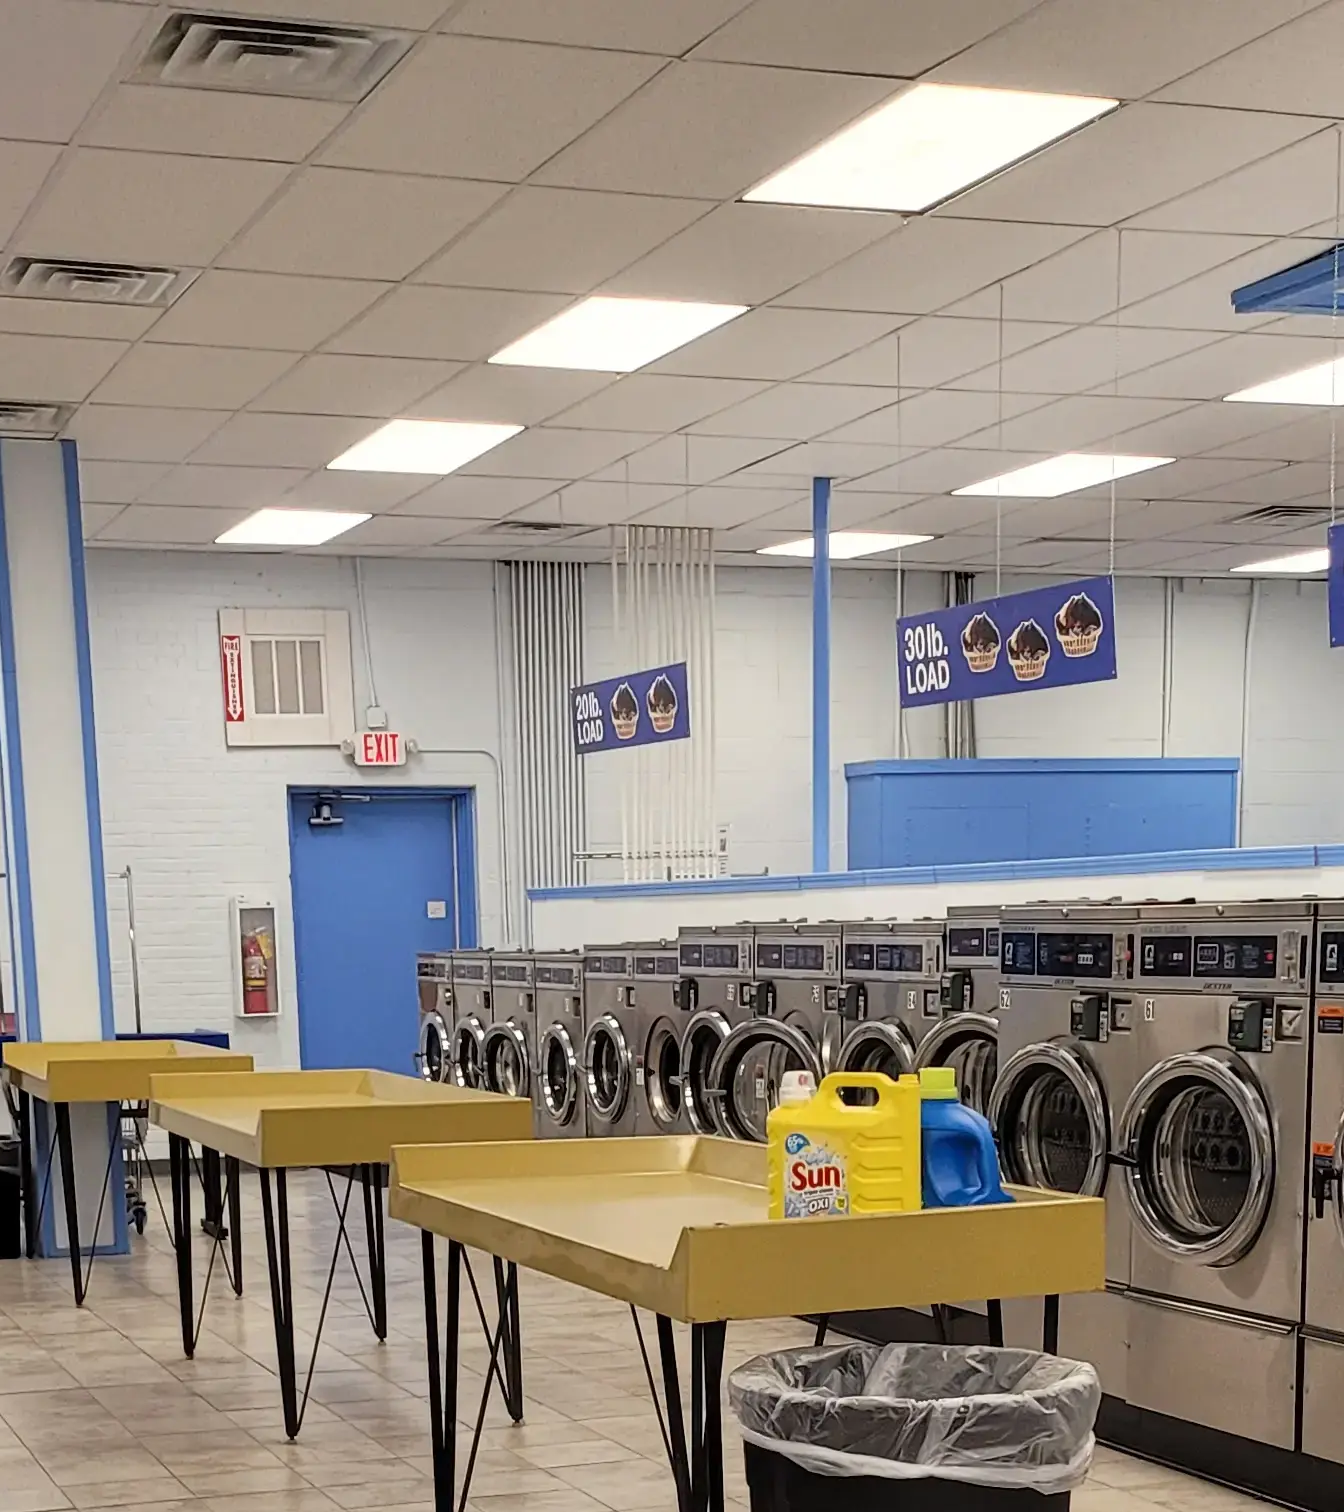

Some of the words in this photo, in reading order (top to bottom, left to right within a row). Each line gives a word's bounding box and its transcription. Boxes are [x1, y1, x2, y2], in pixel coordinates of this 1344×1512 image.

[224, 642, 238, 650] FIRE
[905, 626, 925, 662] 30
[927, 623, 948, 657] lb.
[906, 660, 950, 694] LOAD
[576, 694, 588, 720] 20
[577, 719, 603, 744] LOAD
[363, 734, 398, 762] EXIT
[1000, 990, 1010, 1008] 62
[1145, 1001, 1155, 1019] 61
[792, 1162, 840, 1191] Sun
[809, 1198, 828, 1212] OXI
